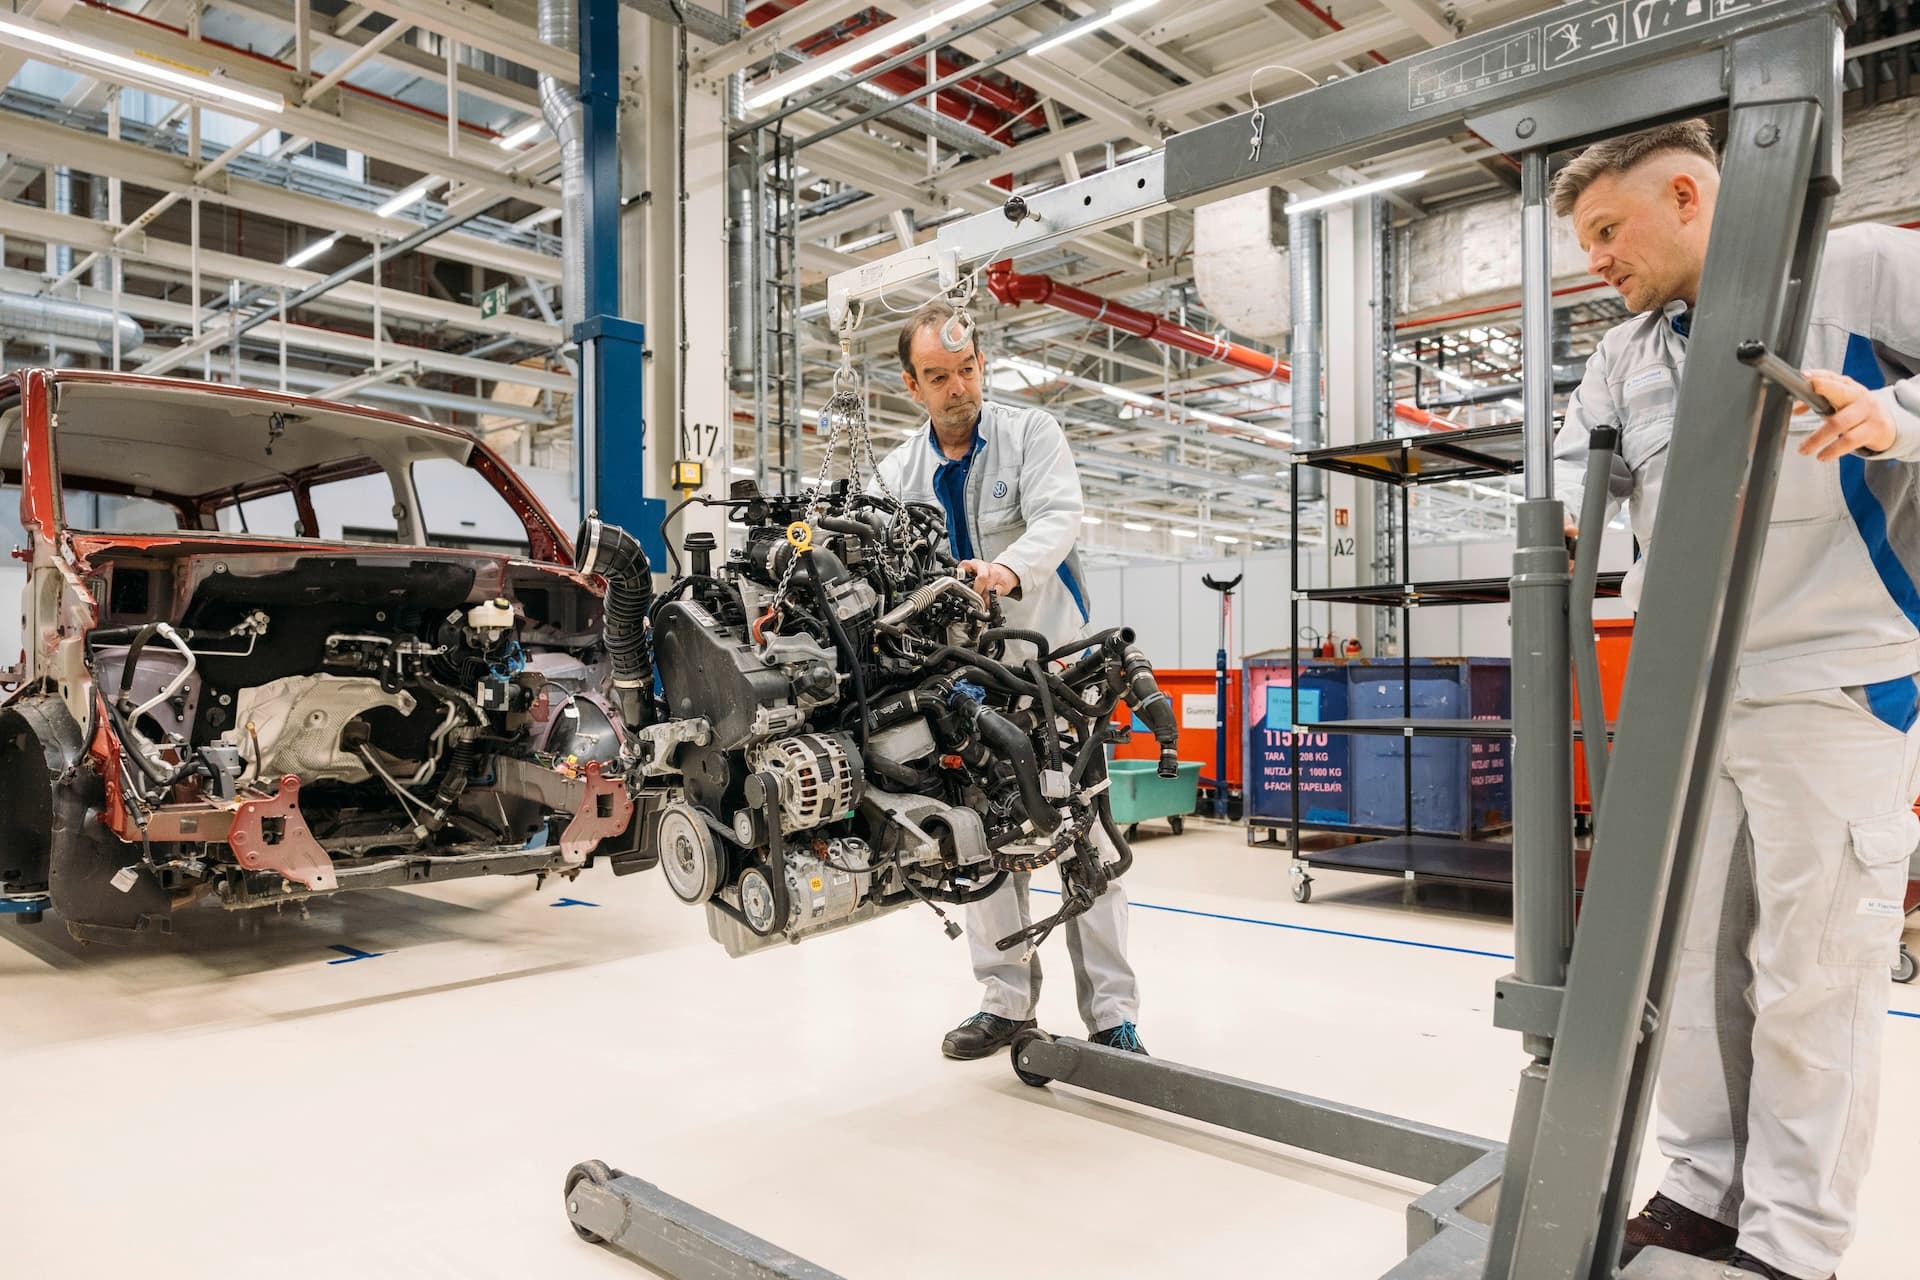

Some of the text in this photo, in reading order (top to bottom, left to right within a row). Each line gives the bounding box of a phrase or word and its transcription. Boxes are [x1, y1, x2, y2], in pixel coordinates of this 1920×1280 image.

[694, 424, 718, 456] 17
[1335, 538, 1355, 556] A2
[1264, 752, 1329, 761] TARA 208 KG
[1264, 767, 1342, 777] NUTZLAT 1000 KG
[1264, 782, 1342, 792] 6-FACH TAPELBAR
